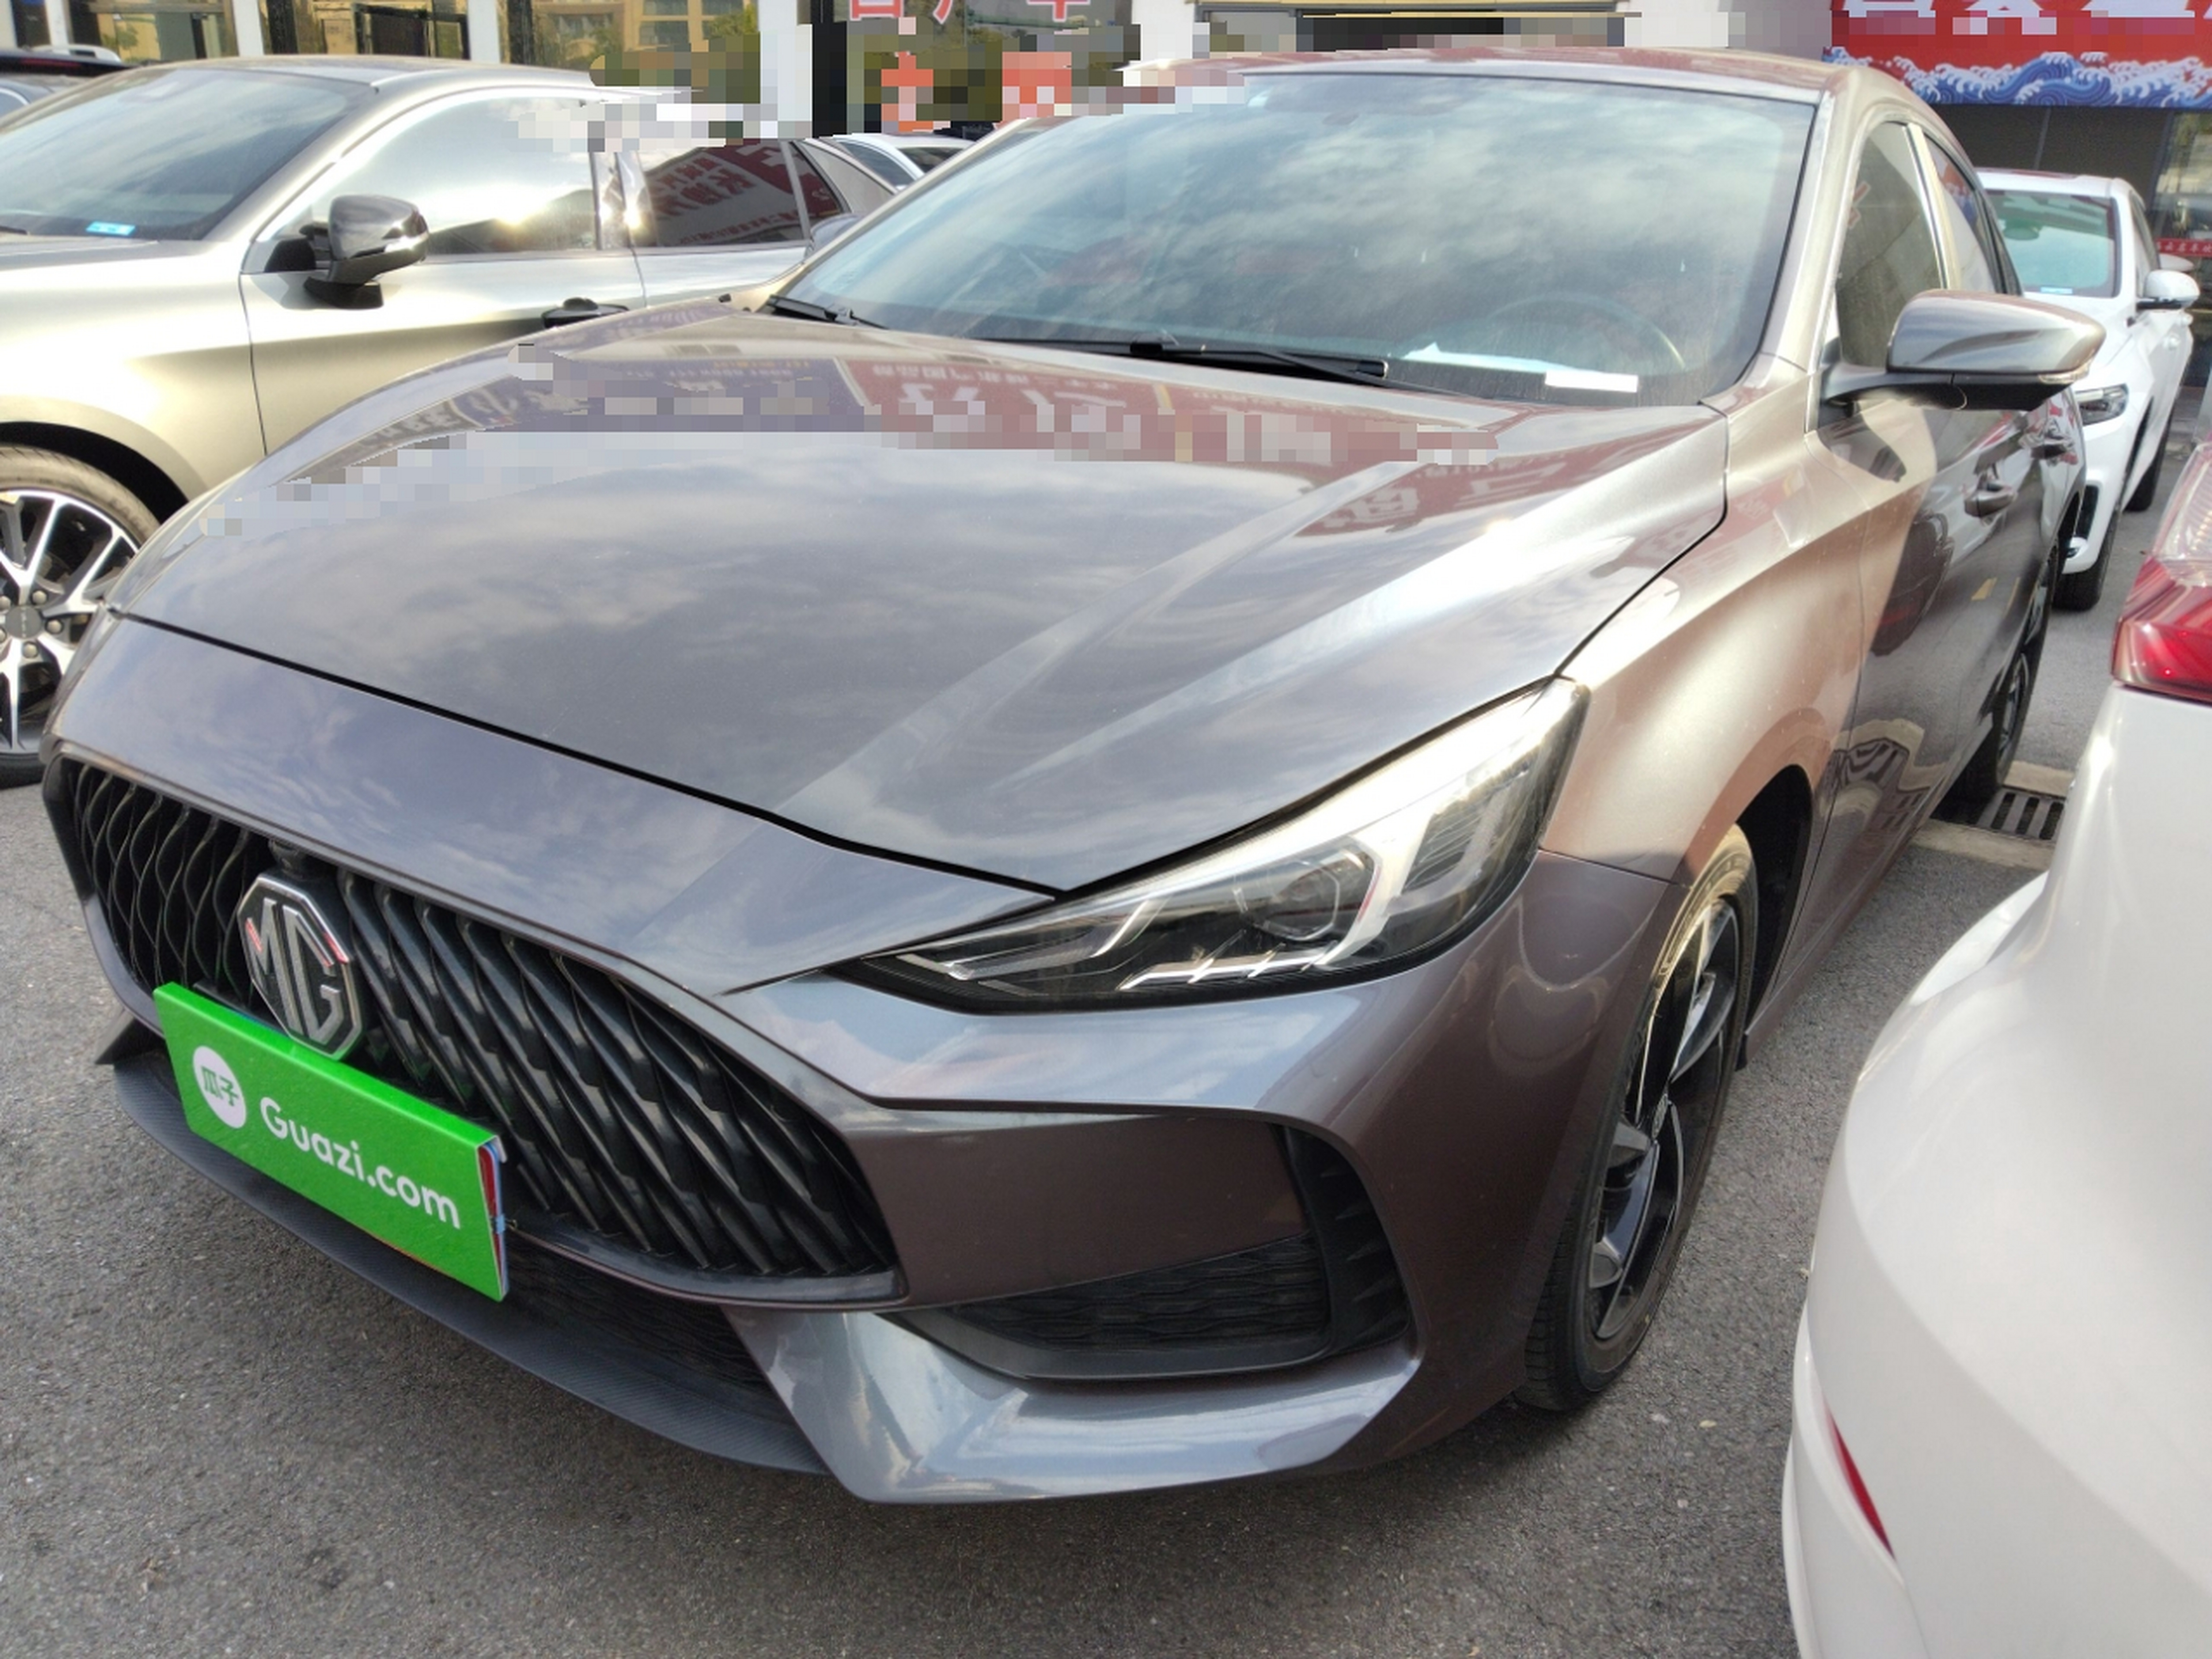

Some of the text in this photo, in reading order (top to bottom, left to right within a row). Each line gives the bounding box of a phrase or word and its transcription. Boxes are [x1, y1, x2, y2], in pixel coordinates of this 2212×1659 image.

[245, 897, 344, 1046] MG
[201, 1066, 239, 1107] 瓜子
[260, 1096, 460, 1229] Guazi.com
